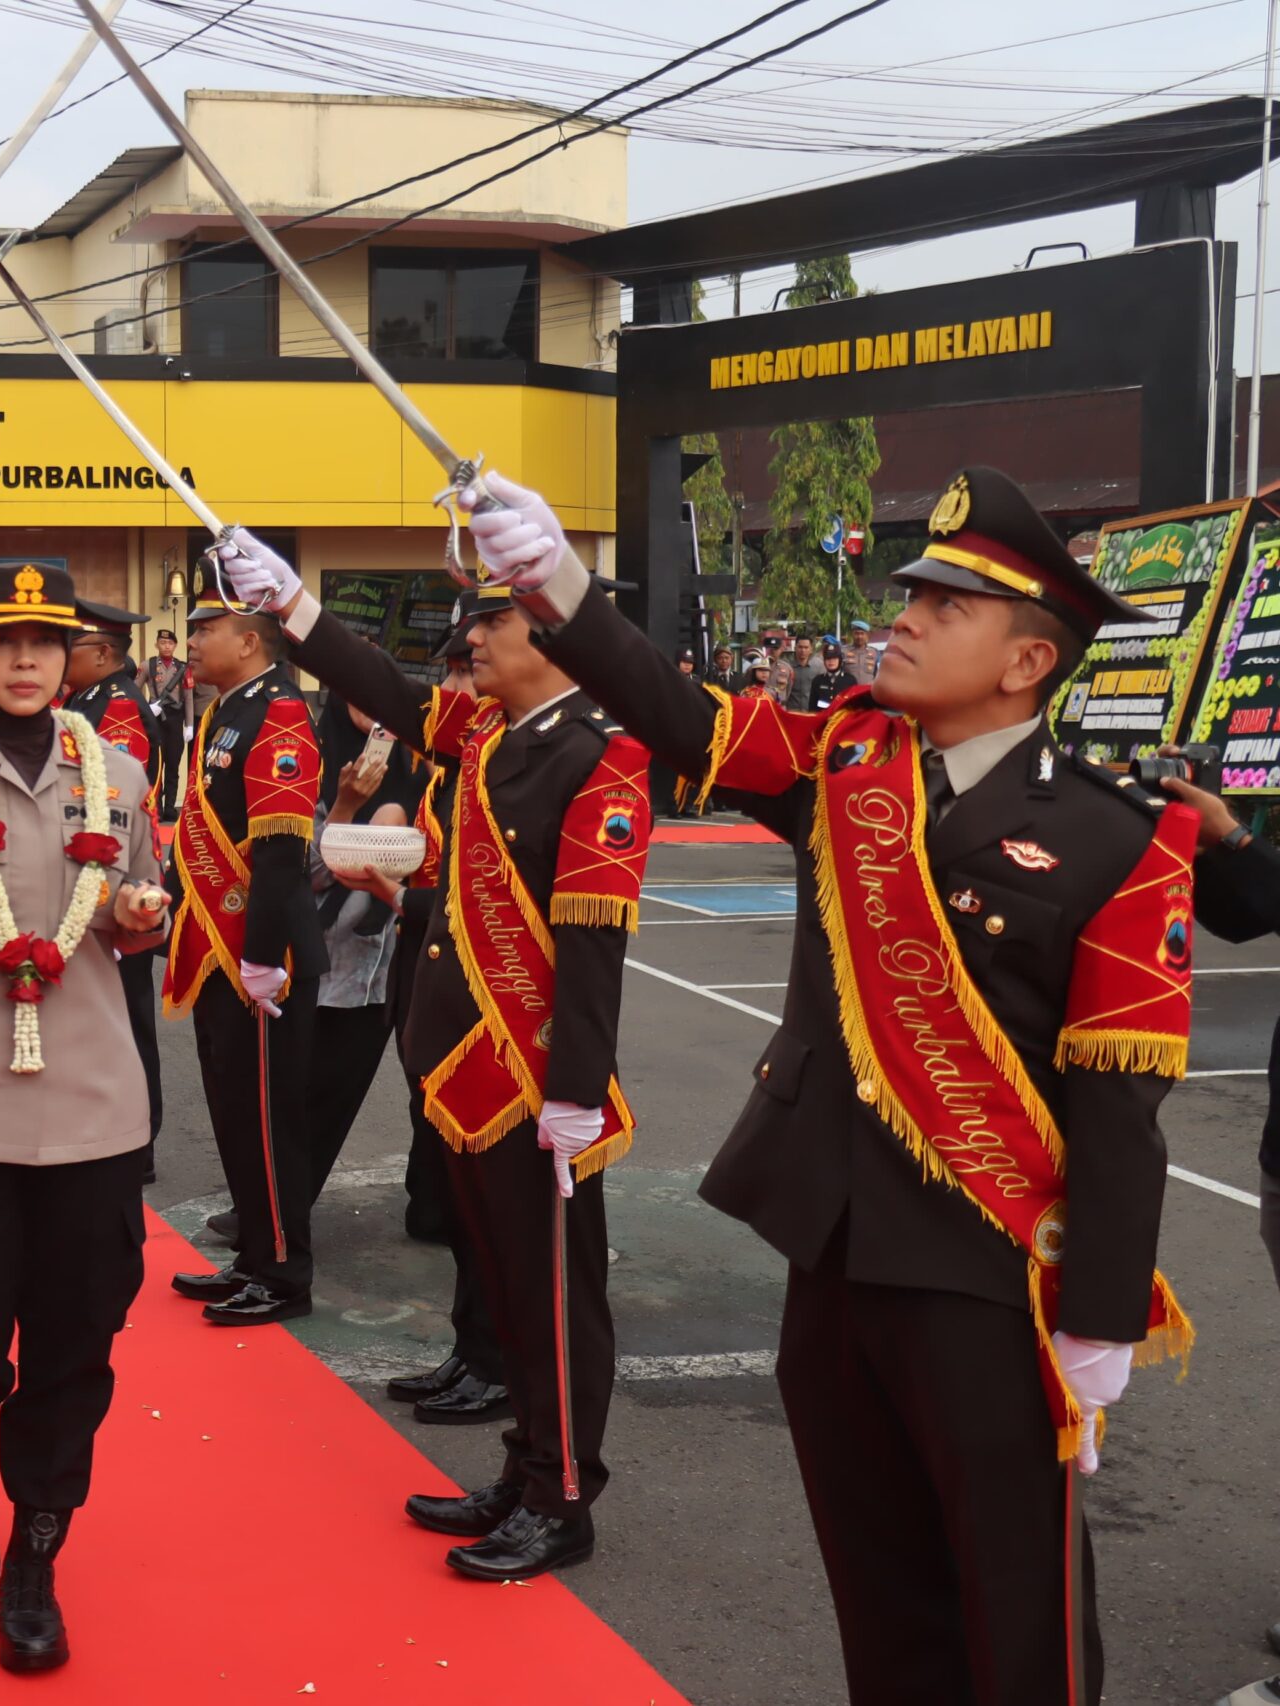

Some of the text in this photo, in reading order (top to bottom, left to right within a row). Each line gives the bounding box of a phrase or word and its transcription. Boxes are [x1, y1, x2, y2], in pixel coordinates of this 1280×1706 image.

[711, 310, 1052, 390] MENGAYOMI DAN MELAYANI
[65, 805, 127, 829] PRI
[467, 842, 546, 1012] Purbalingga
[846, 788, 1032, 1199] Polres Purbalingga
